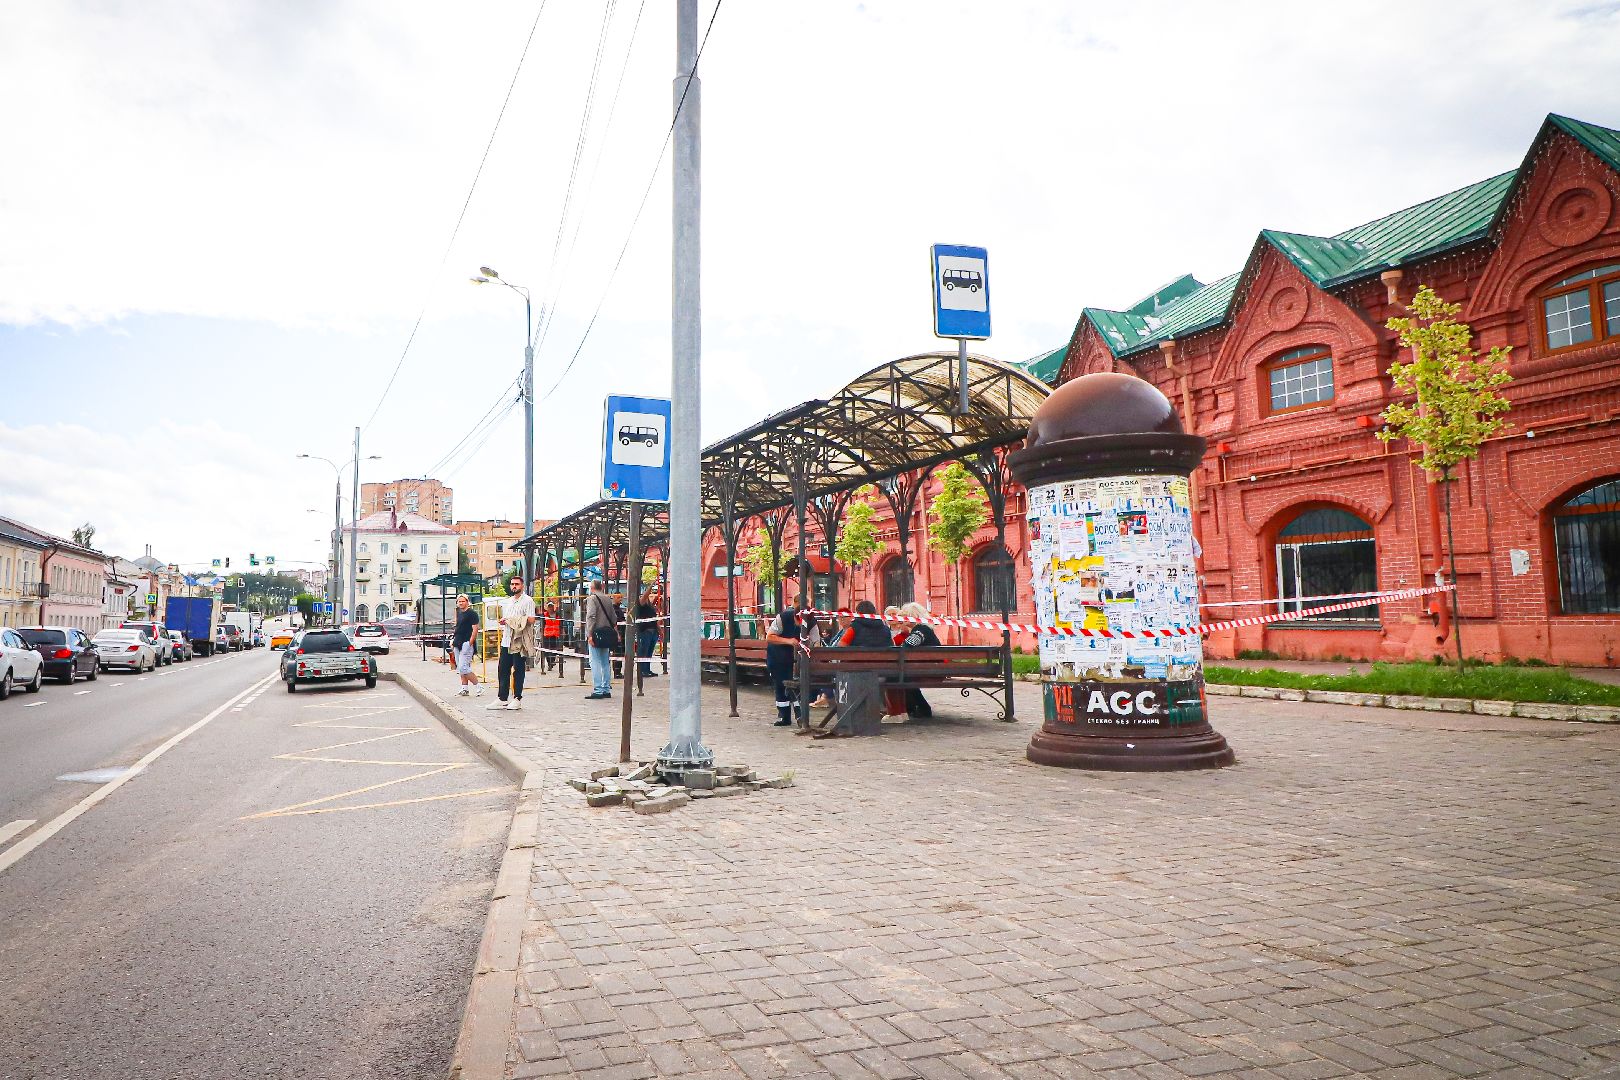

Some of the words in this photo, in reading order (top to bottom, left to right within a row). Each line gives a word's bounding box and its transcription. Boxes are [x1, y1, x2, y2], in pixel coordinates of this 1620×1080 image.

[1098, 480, 1139, 488] ДОСТАВКА
[1046, 489, 1056, 498] 22
[1063, 488, 1074, 496] 21
[1167, 568, 1178, 576] 22
[1086, 690, 1157, 715] AGC
